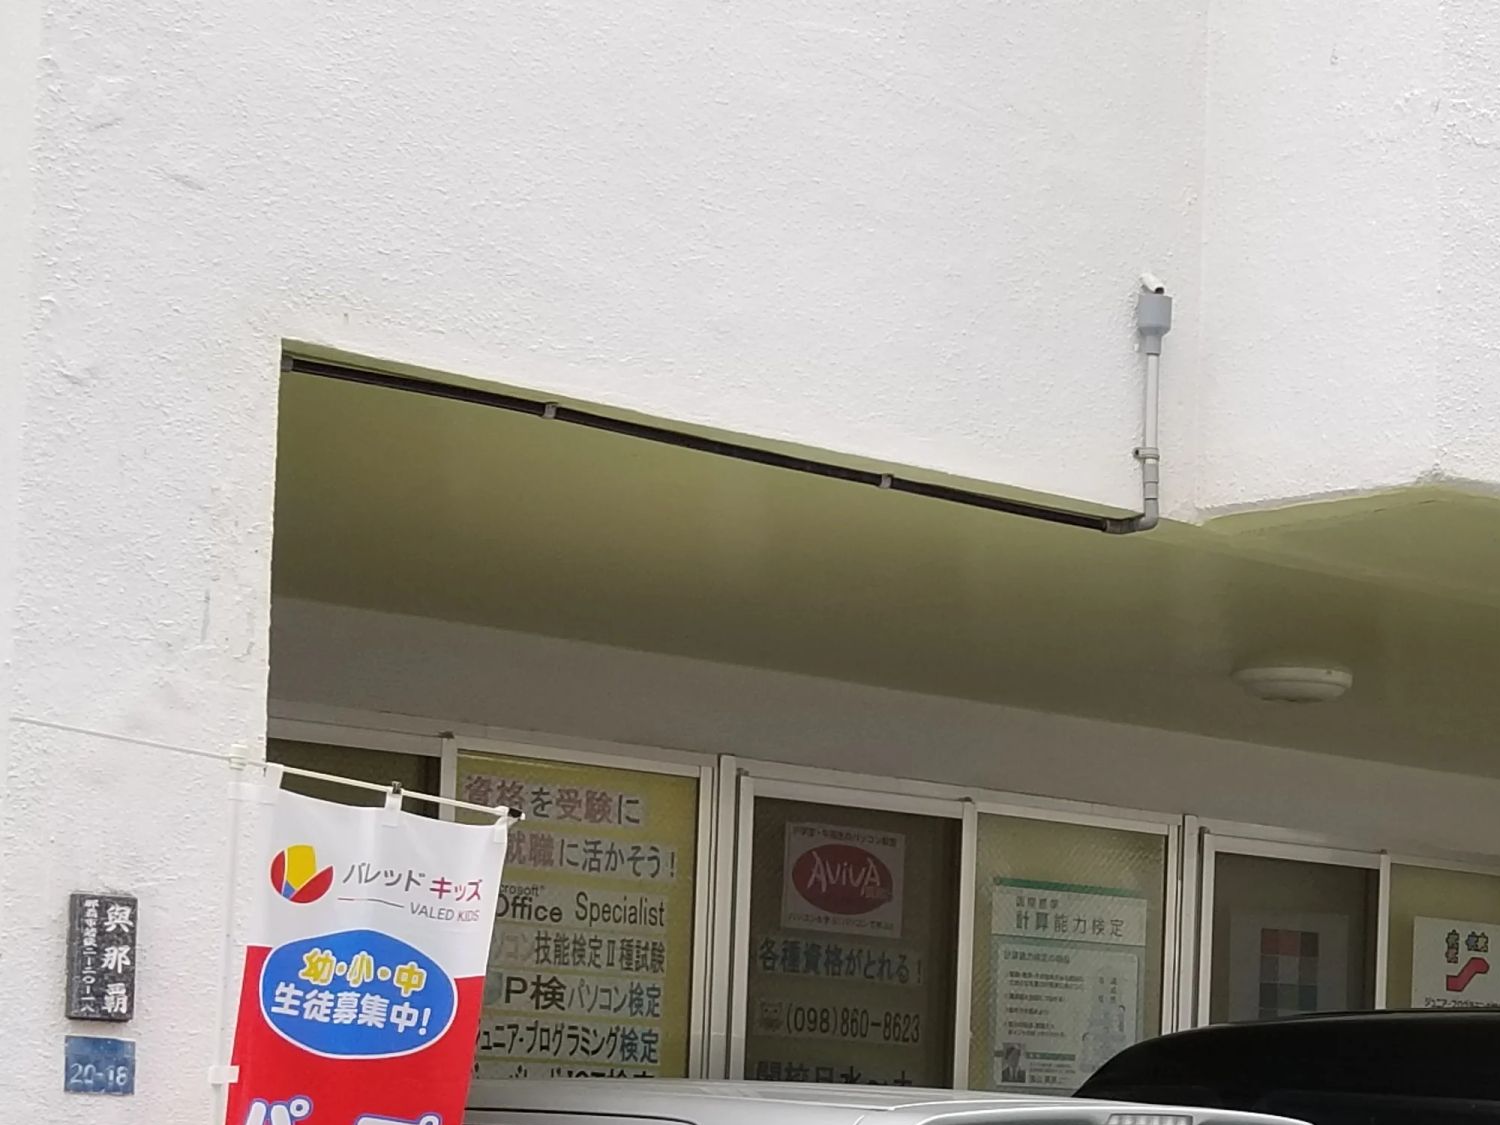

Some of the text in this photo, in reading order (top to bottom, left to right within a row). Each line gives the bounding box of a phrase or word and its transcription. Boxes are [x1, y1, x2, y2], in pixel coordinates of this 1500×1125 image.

[342, 862, 482, 902] バレッド キッズ
[498, 883, 546, 897] crosoft
[410, 902, 480, 922] VALED KIDS
[575, 891, 665, 927] Specialist
[298, 947, 427, 997] 幼・小・中
[478, 1019, 659, 1063] ュニア・プログラミング検定
[786, 1002, 921, 1043] (098)860-8623
